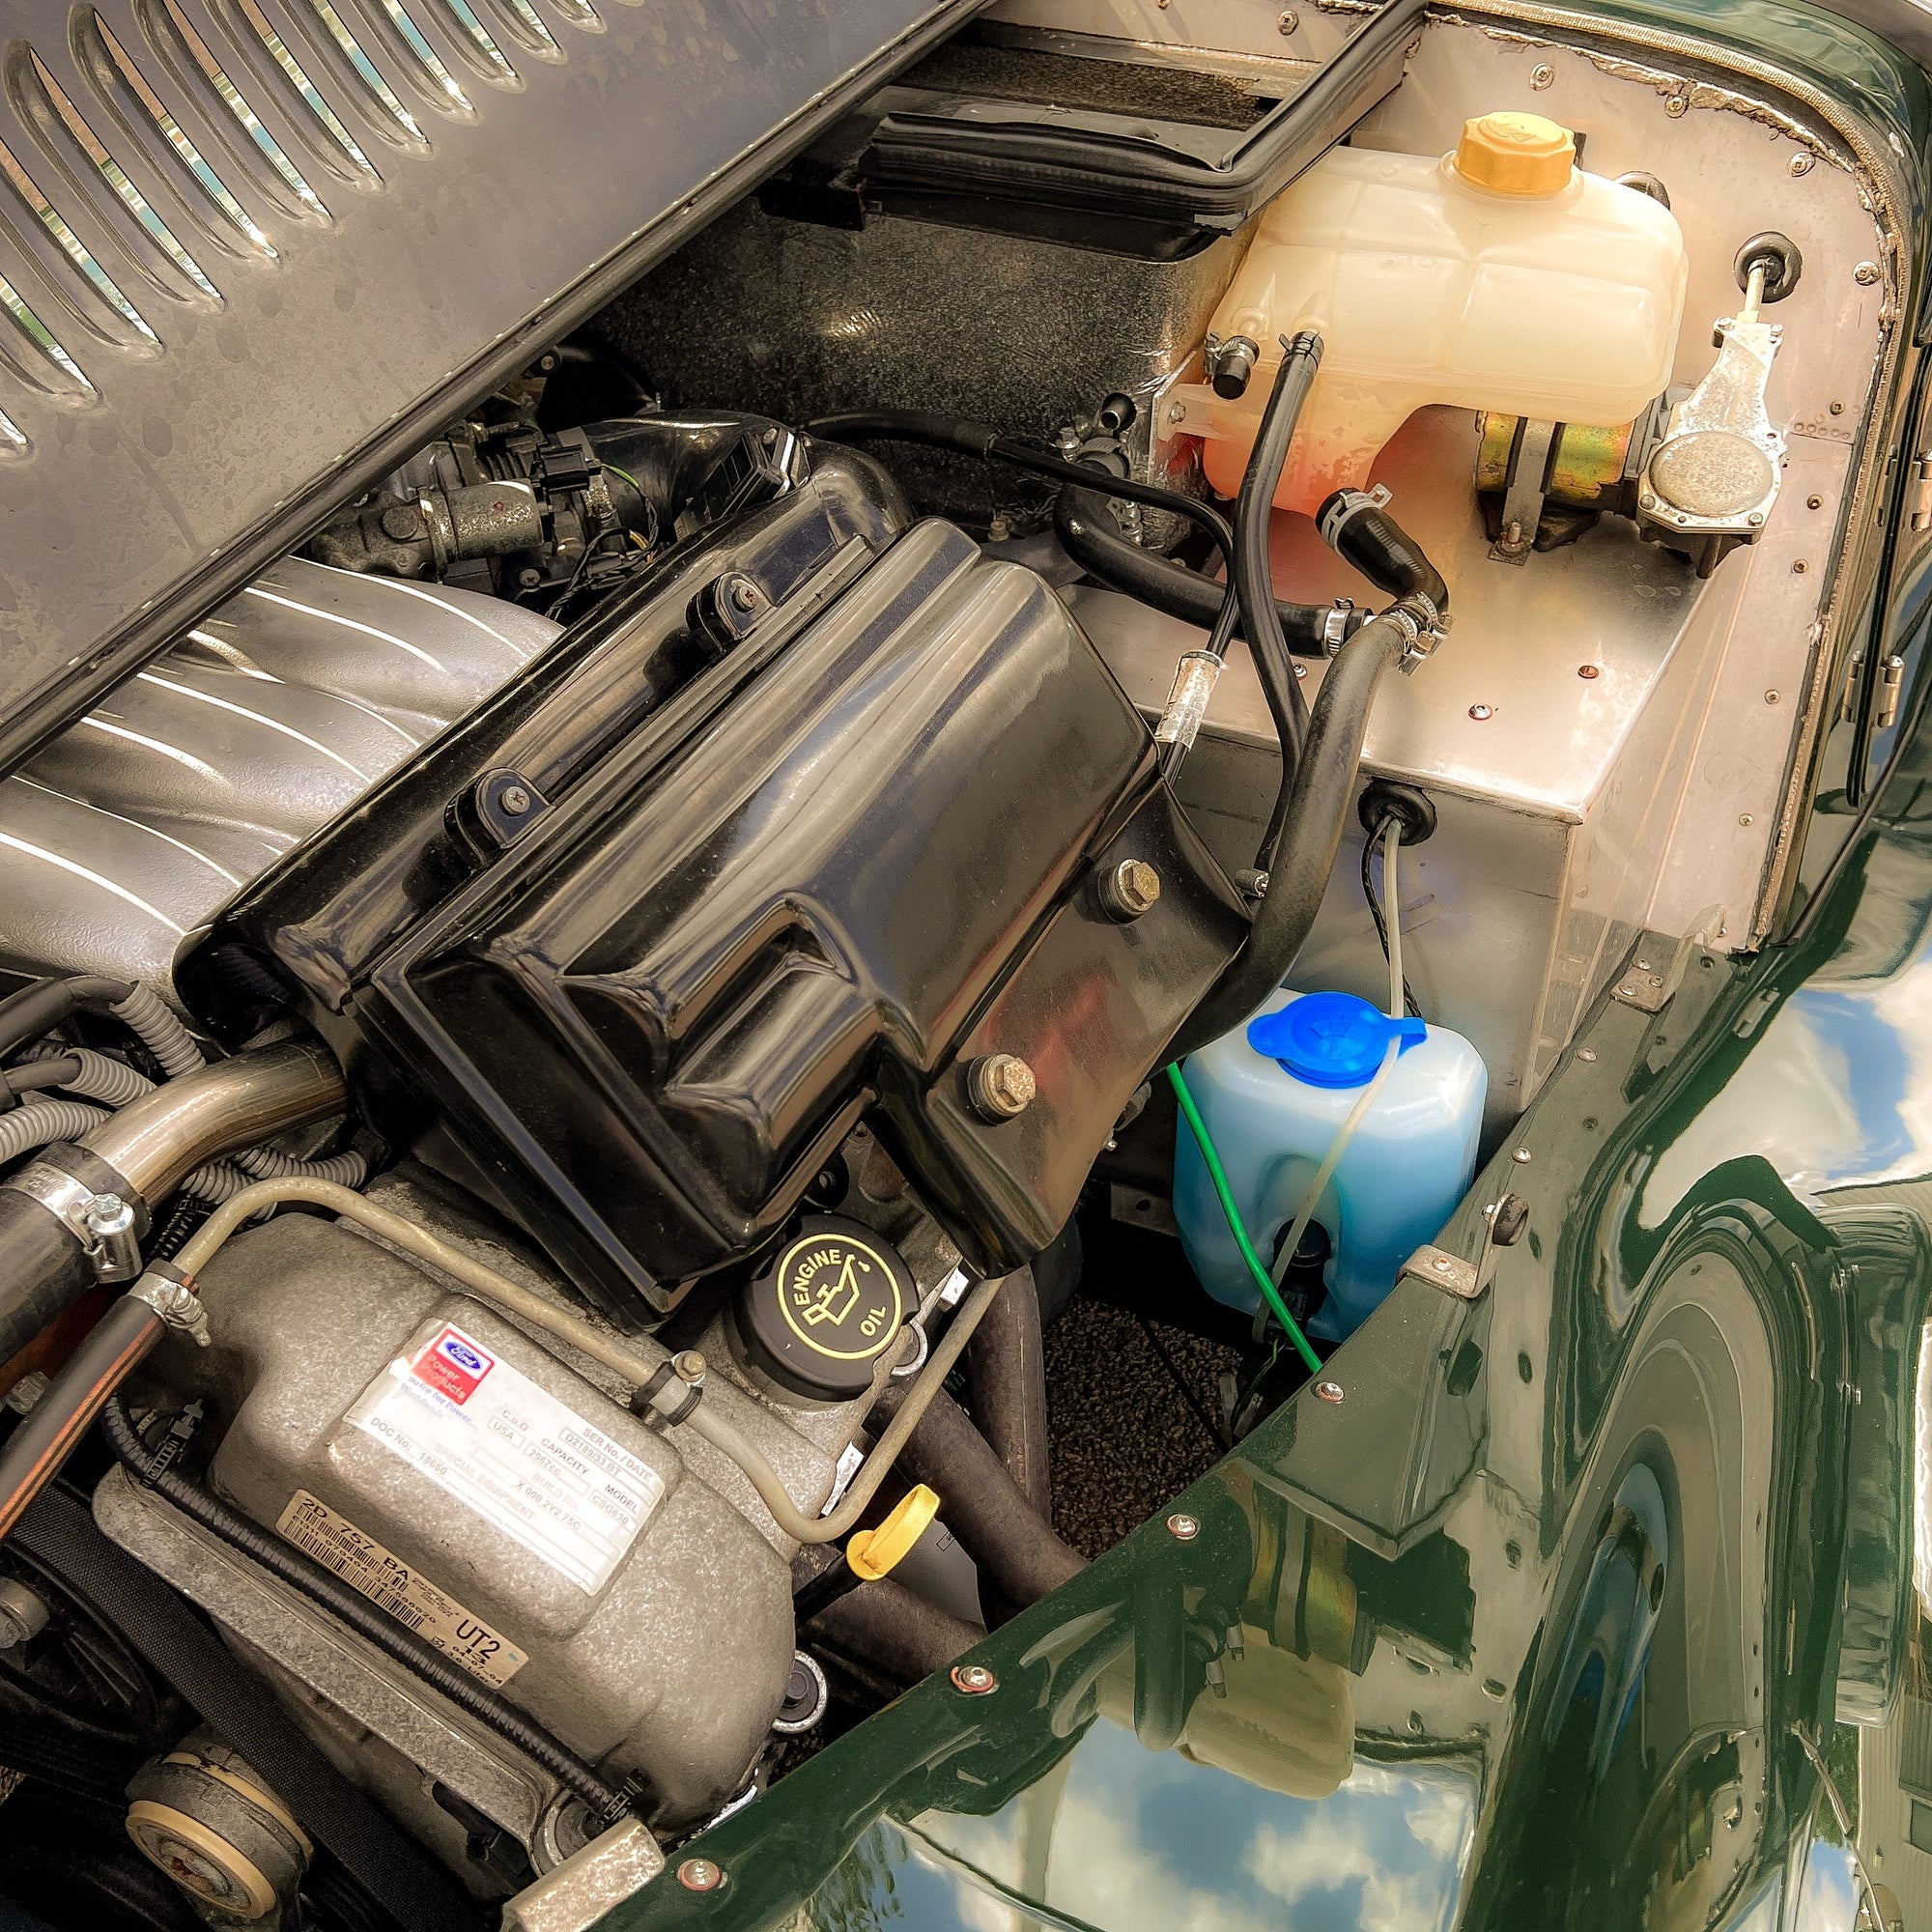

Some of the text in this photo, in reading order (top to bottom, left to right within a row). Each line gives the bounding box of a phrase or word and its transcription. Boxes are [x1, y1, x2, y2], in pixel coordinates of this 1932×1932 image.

[793, 1249, 842, 1305] ENGINE
[859, 1306, 886, 1336] OIL
[426, 1353, 461, 1383] Power
[407, 1375, 433, 1397] ource
[370, 1415, 396, 1438] DOC
[493, 1420, 516, 1441] USA
[540, 1436, 589, 1478] CAPACITY
[582, 1427, 606, 1448] SER
[603, 1442, 622, 1461] No.
[624, 1458, 653, 1483] DATE
[603, 1483, 640, 1516] MODEL
[301, 1496, 412, 1581] 2D 757 BA
[454, 1617, 502, 1662] UT2
